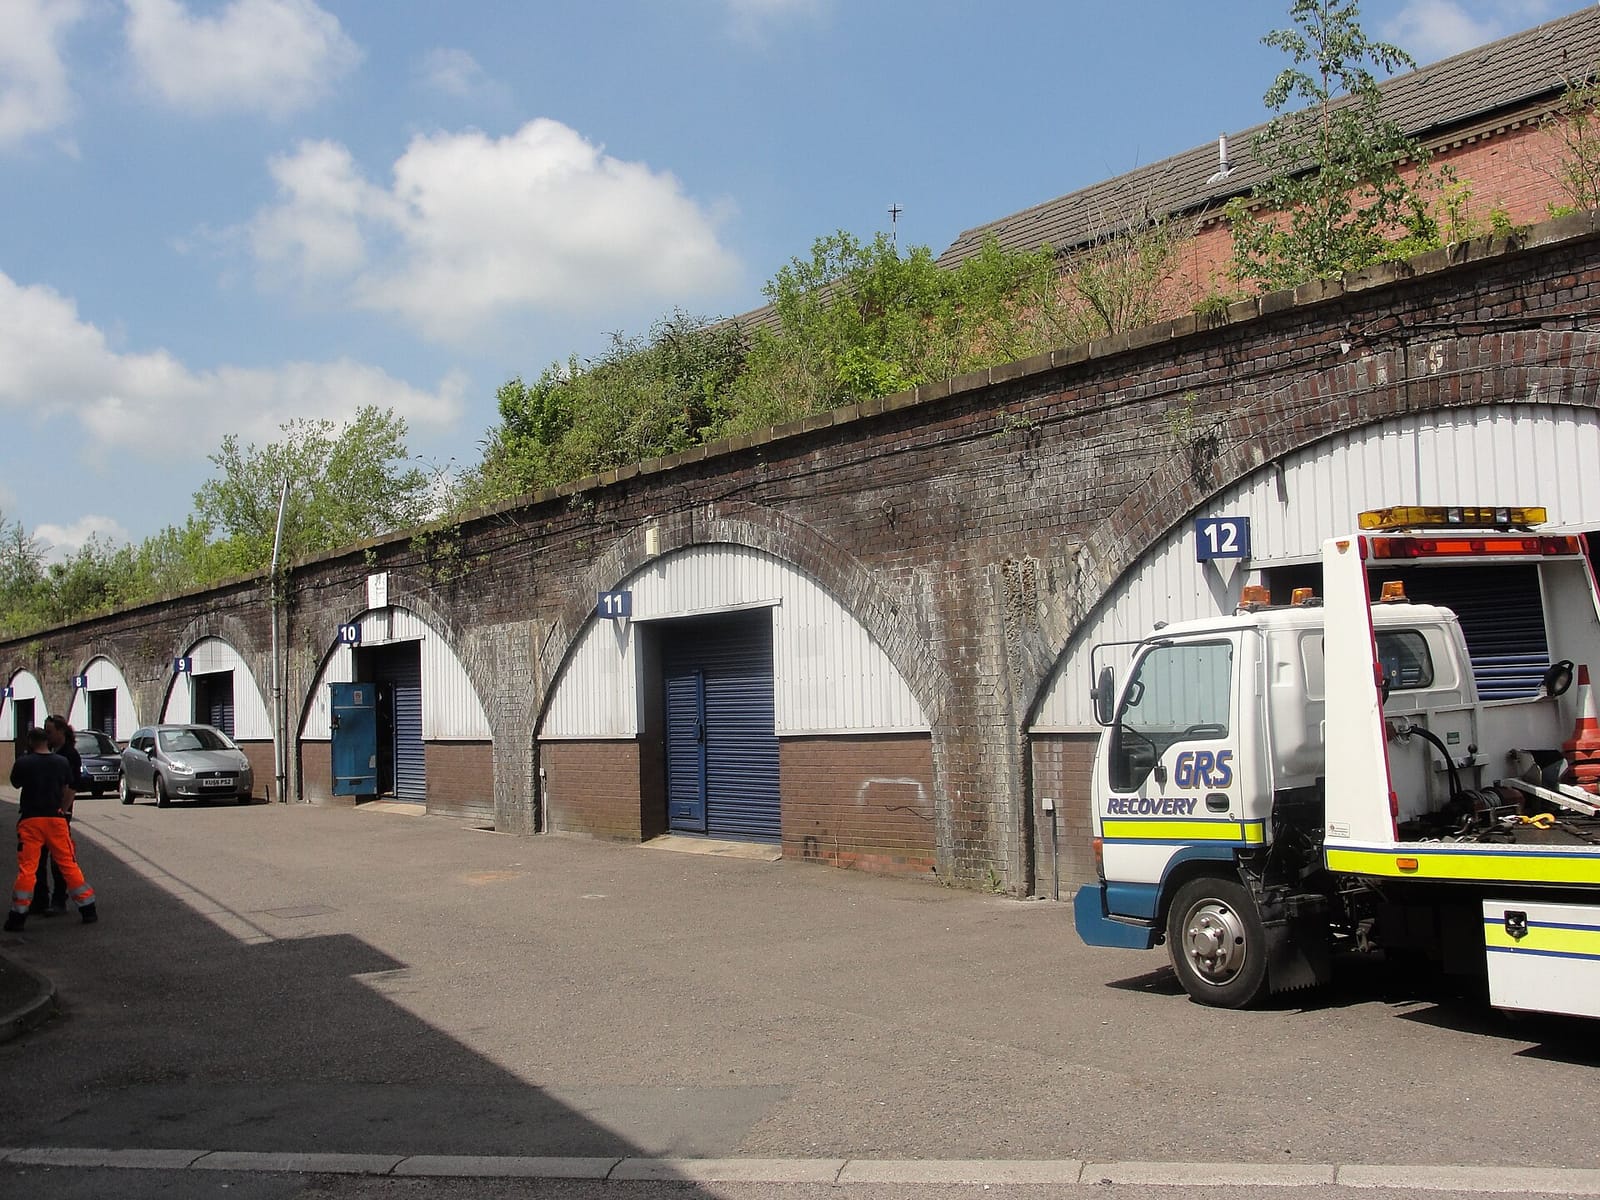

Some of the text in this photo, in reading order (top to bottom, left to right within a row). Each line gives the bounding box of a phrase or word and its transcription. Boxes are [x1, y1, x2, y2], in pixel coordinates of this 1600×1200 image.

[1203, 522, 1239, 553] 12
[603, 594, 622, 614] 11
[340, 626, 356, 641] 10
[178, 659, 185, 671] 9
[76, 676, 82, 687] 8
[4, 688, 9, 697] 7
[1174, 750, 1233, 790] GRS
[1106, 797, 1198, 815] RECOVERY
